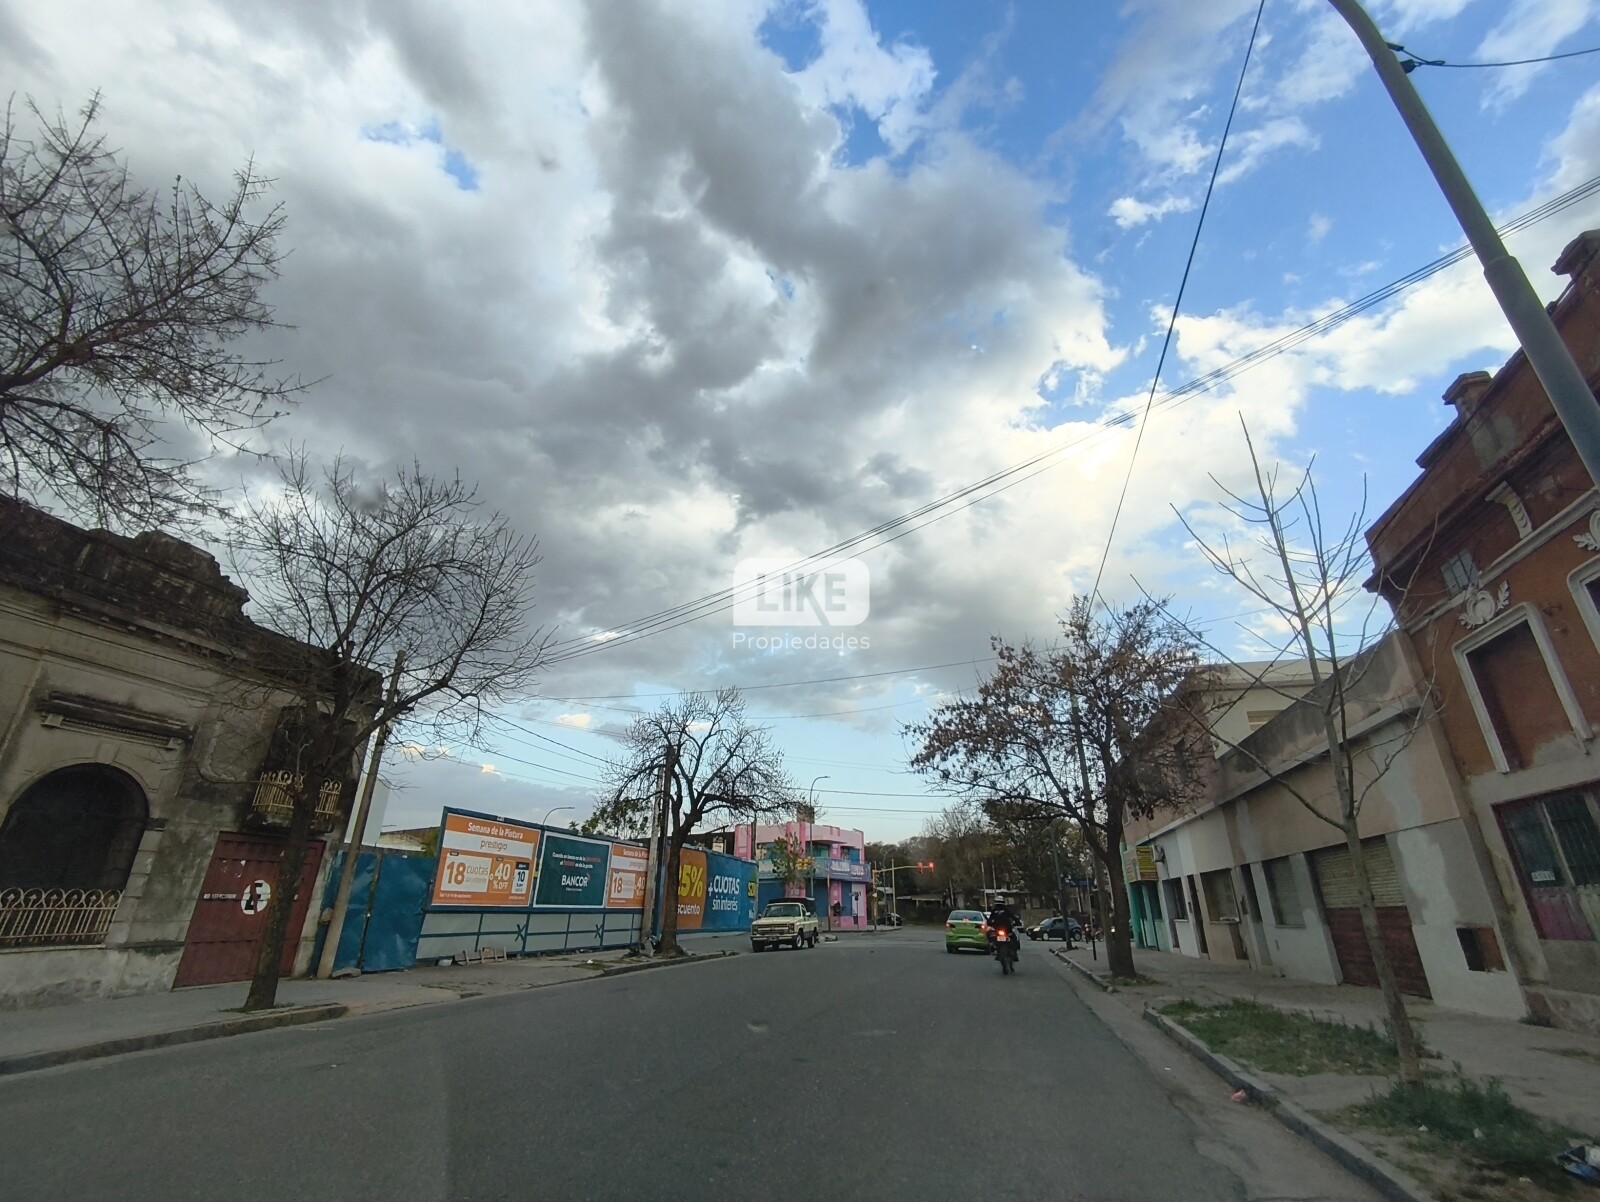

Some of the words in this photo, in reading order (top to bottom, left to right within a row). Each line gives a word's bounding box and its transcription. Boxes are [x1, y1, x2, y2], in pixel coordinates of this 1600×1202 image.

[467, 822, 491, 834] Semana
[490, 826, 498, 836] de
[499, 827, 505, 836] la
[504, 828, 524, 840] Pintura
[480, 840, 508, 851] prestigio
[446, 861, 467, 885] 18
[466, 864, 489, 876] cuotas
[494, 863, 511, 881] 40
[517, 870, 526, 882] 10
[561, 874, 588, 887] BANCOR
[612, 877, 623, 893] 18
[678, 864, 703, 898] 5%
[712, 896, 720, 911] sin
